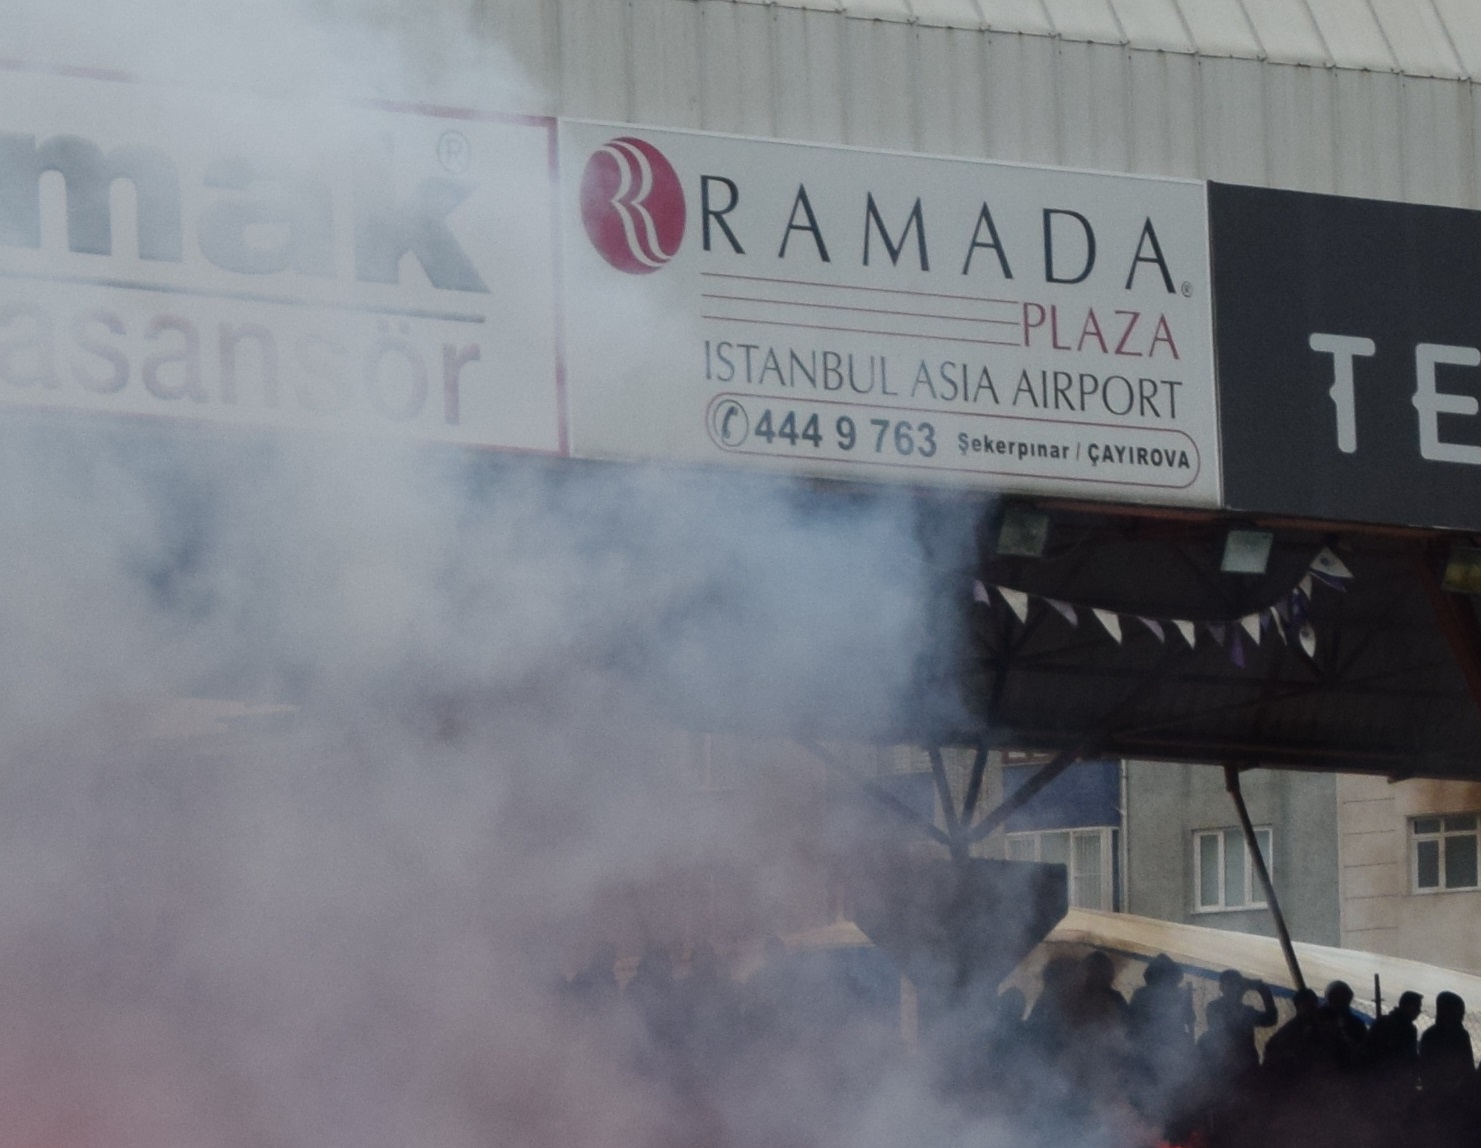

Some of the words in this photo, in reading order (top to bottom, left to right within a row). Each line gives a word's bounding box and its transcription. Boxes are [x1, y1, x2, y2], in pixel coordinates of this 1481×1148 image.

[700, 174, 1177, 294] RAMADA
[1023, 302, 1181, 360] PLAZA
[911, 359, 1000, 405] ASIA
[1012, 369, 1183, 419] AIRPORT
[755, 411, 823, 448] 444
[836, 416, 856, 451] 9
[874, 419, 938, 458] 763
[1087, 443, 1190, 469] ÇAYIROVA
